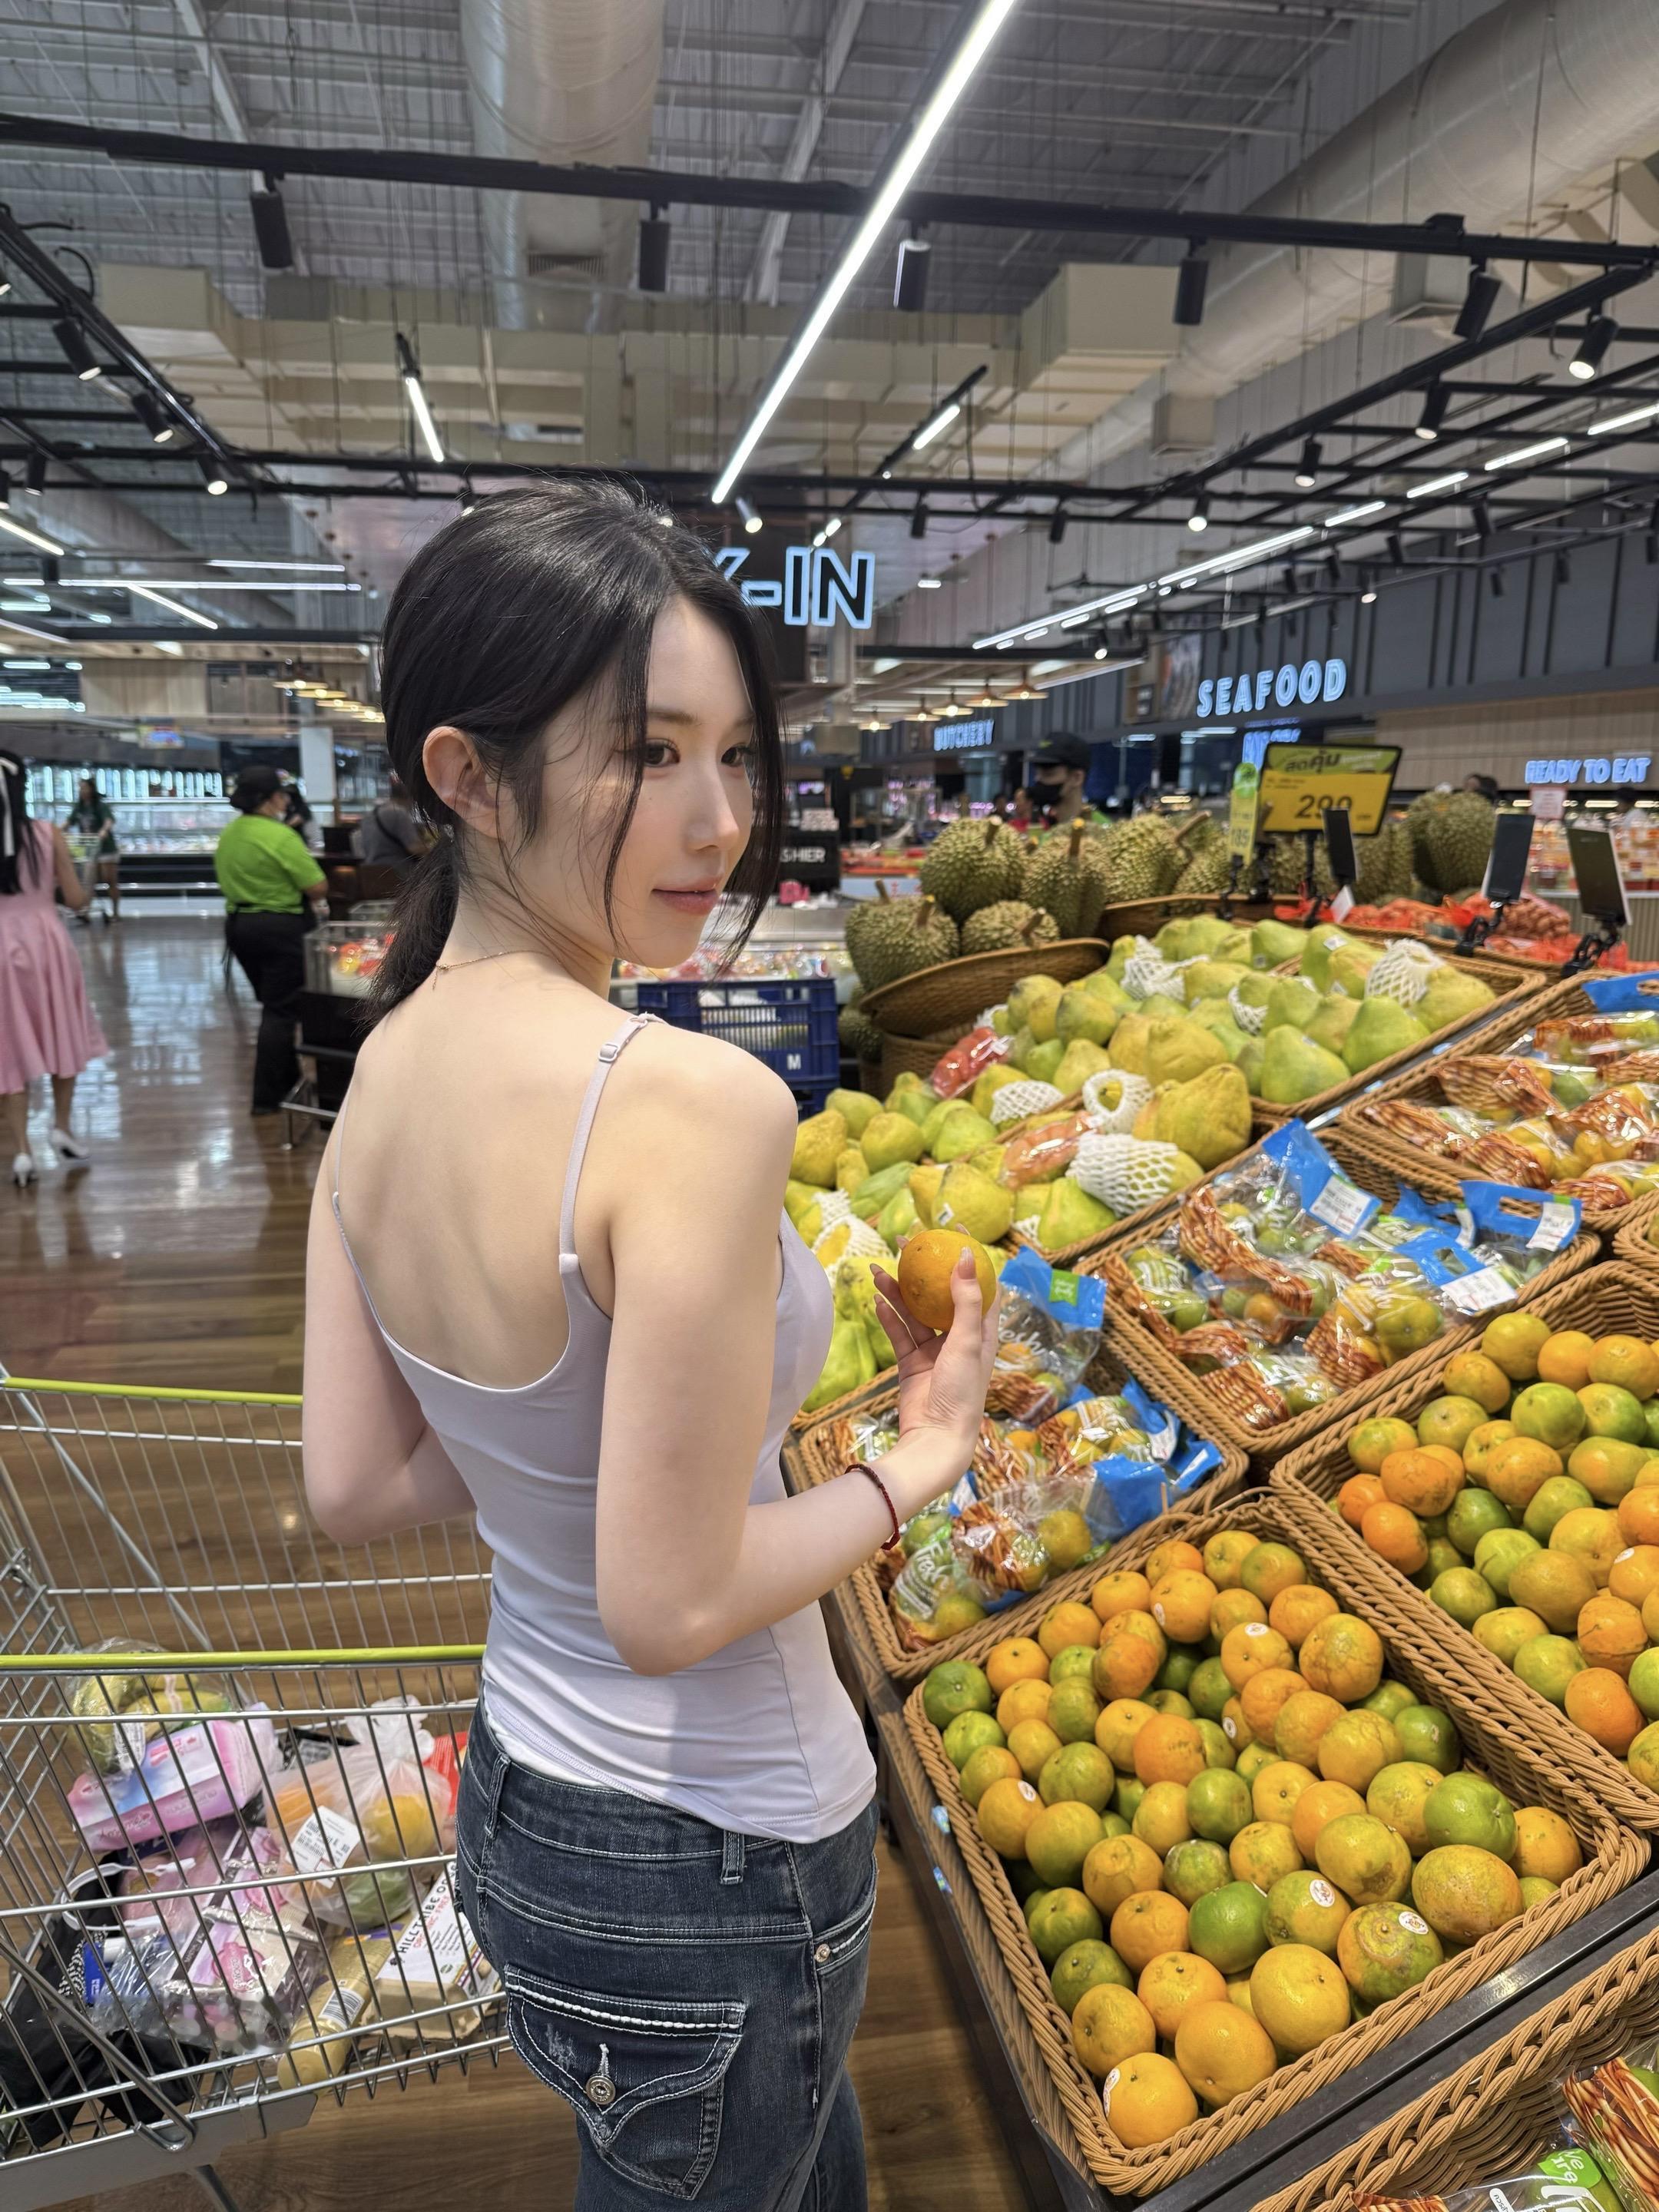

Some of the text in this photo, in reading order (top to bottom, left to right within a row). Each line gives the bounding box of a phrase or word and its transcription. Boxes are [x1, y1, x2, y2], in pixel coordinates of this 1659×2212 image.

[1197, 658, 1347, 717] SEAFOOD
[1525, 757, 1651, 783] READY TO EAT
[786, 1054, 802, 1070] M
